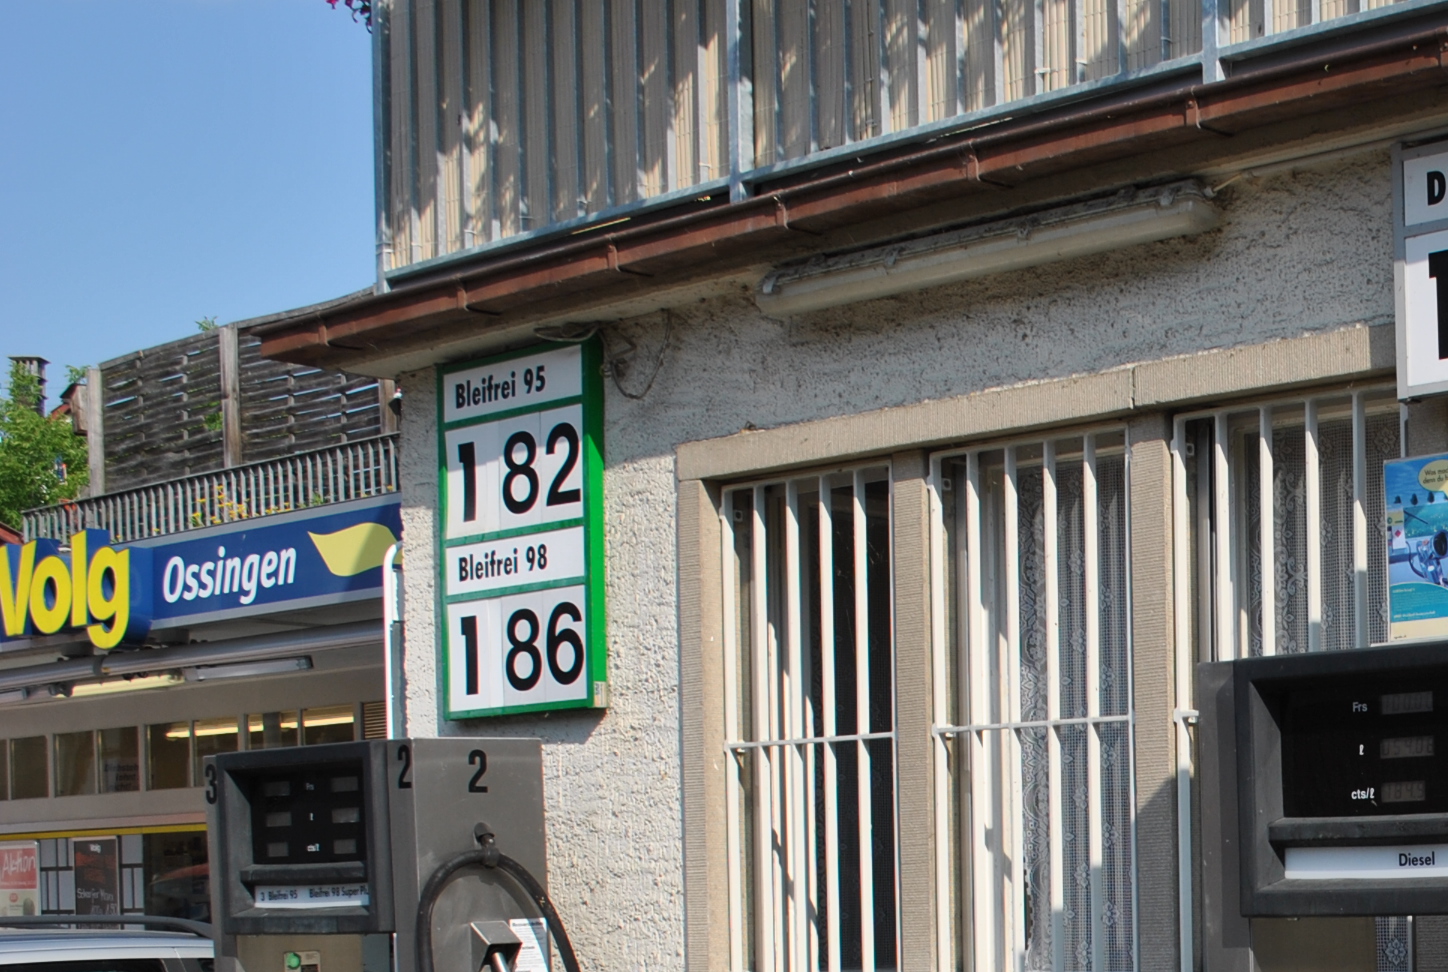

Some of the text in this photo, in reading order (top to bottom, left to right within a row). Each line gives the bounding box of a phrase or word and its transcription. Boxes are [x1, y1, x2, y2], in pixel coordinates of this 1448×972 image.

[454, 365, 546, 409] Bleifrei 95
[459, 544, 547, 581] Bleifrei 98
[0, 530, 296, 649] Volg Ossingen
[1352, 702, 1368, 712] Frs
[205, 764, 217, 804] 3
[398, 744, 412, 789] 2
[468, 749, 489, 793] 2
[1398, 851, 1435, 867] Diesel
[268, 891, 288, 901] Bleifrei
[290, 890, 298, 899] 95
[309, 888, 330, 898] Bleifrei
[331, 887, 340, 897] 98
[341, 887, 359, 898] Super
